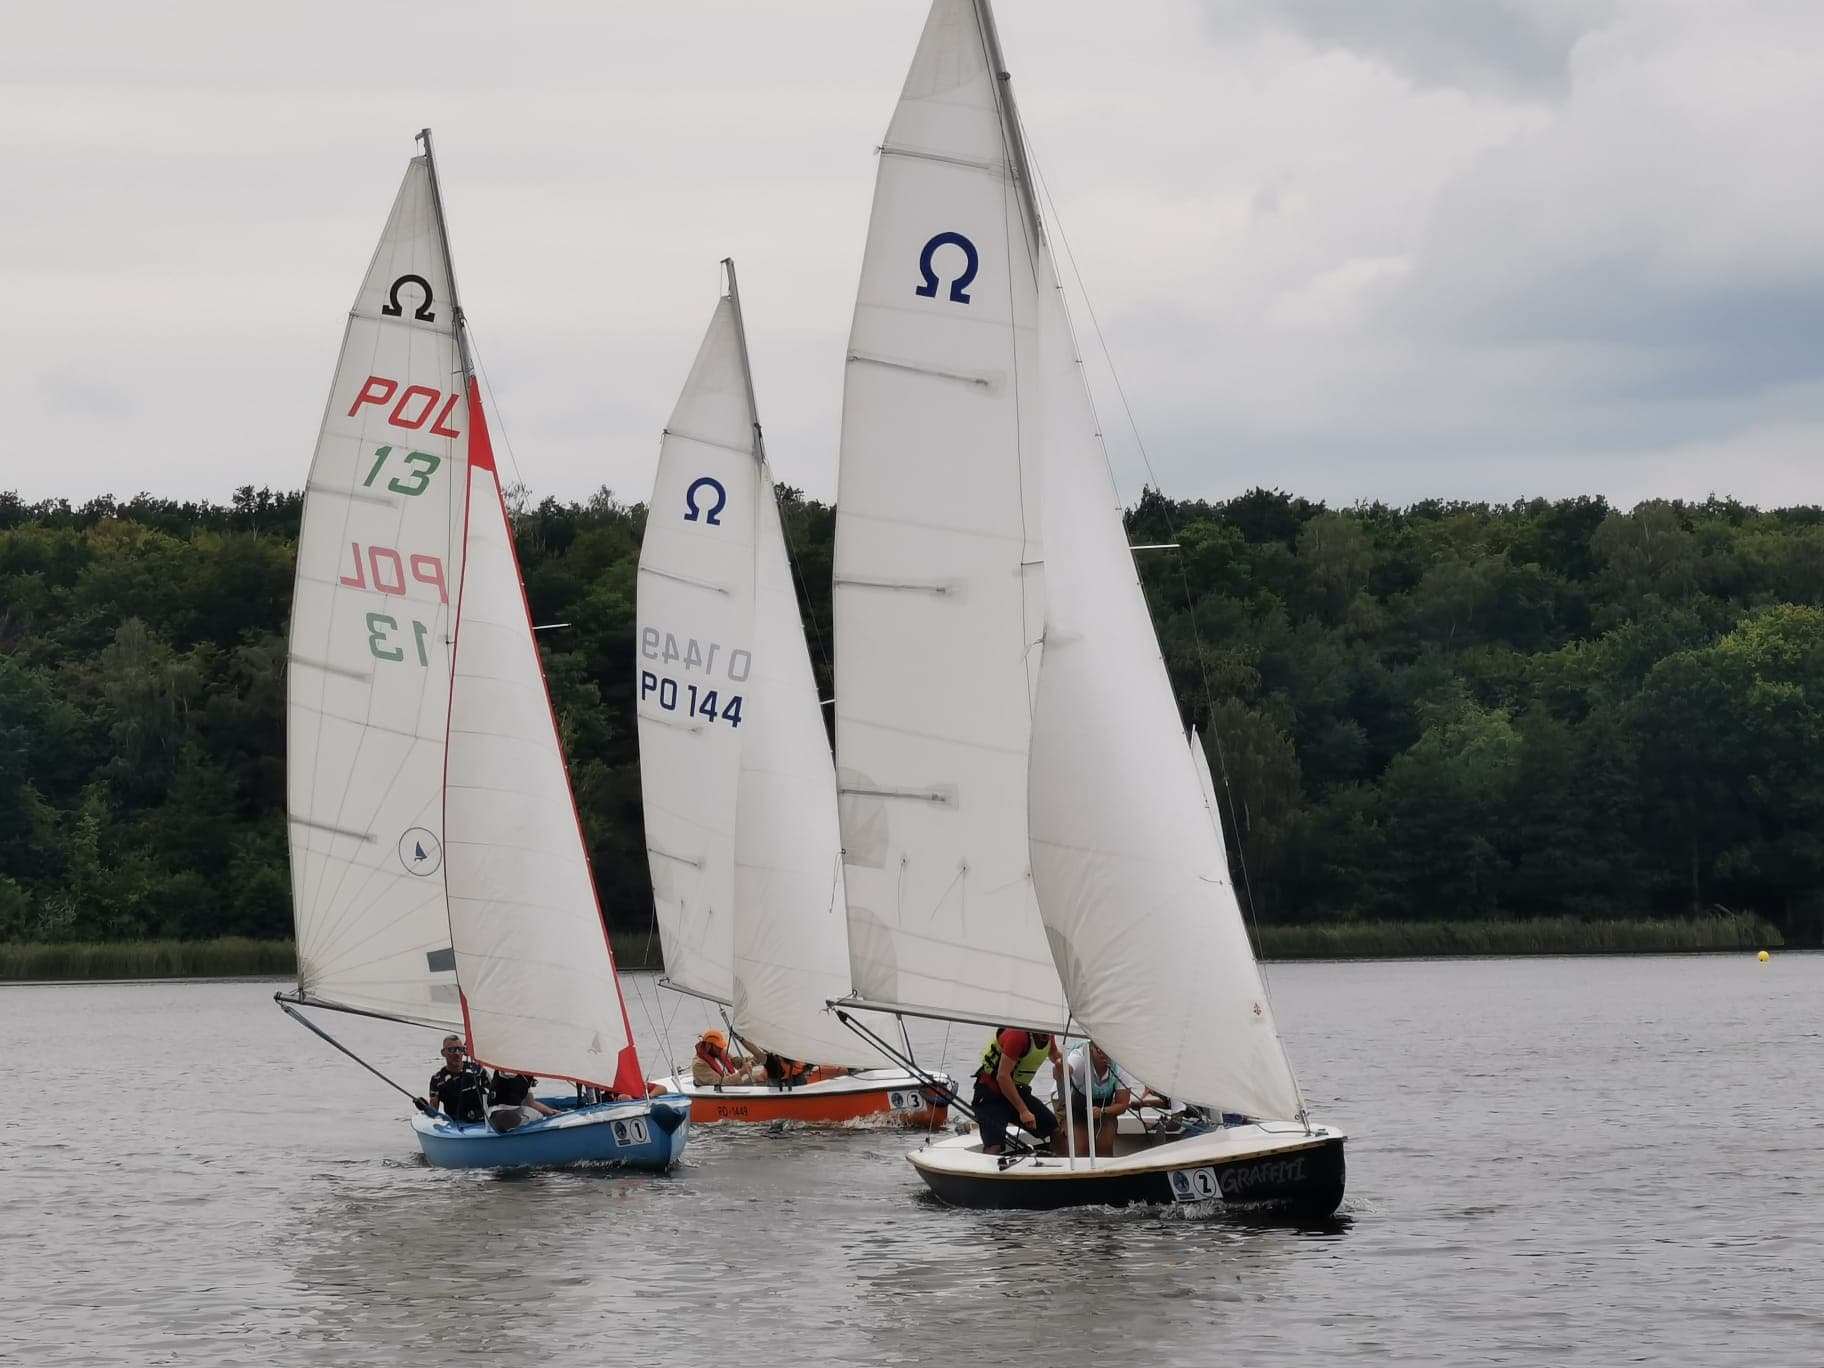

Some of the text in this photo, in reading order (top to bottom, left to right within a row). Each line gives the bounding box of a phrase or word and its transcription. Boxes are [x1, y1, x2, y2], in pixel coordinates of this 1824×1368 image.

[348, 376, 460, 438] POL
[363, 446, 441, 496] 13
[641, 670, 742, 728] PO 144
[911, 1094, 920, 1107] 3
[634, 1122, 643, 1139] 1
[1199, 1174, 1212, 1194] 2
